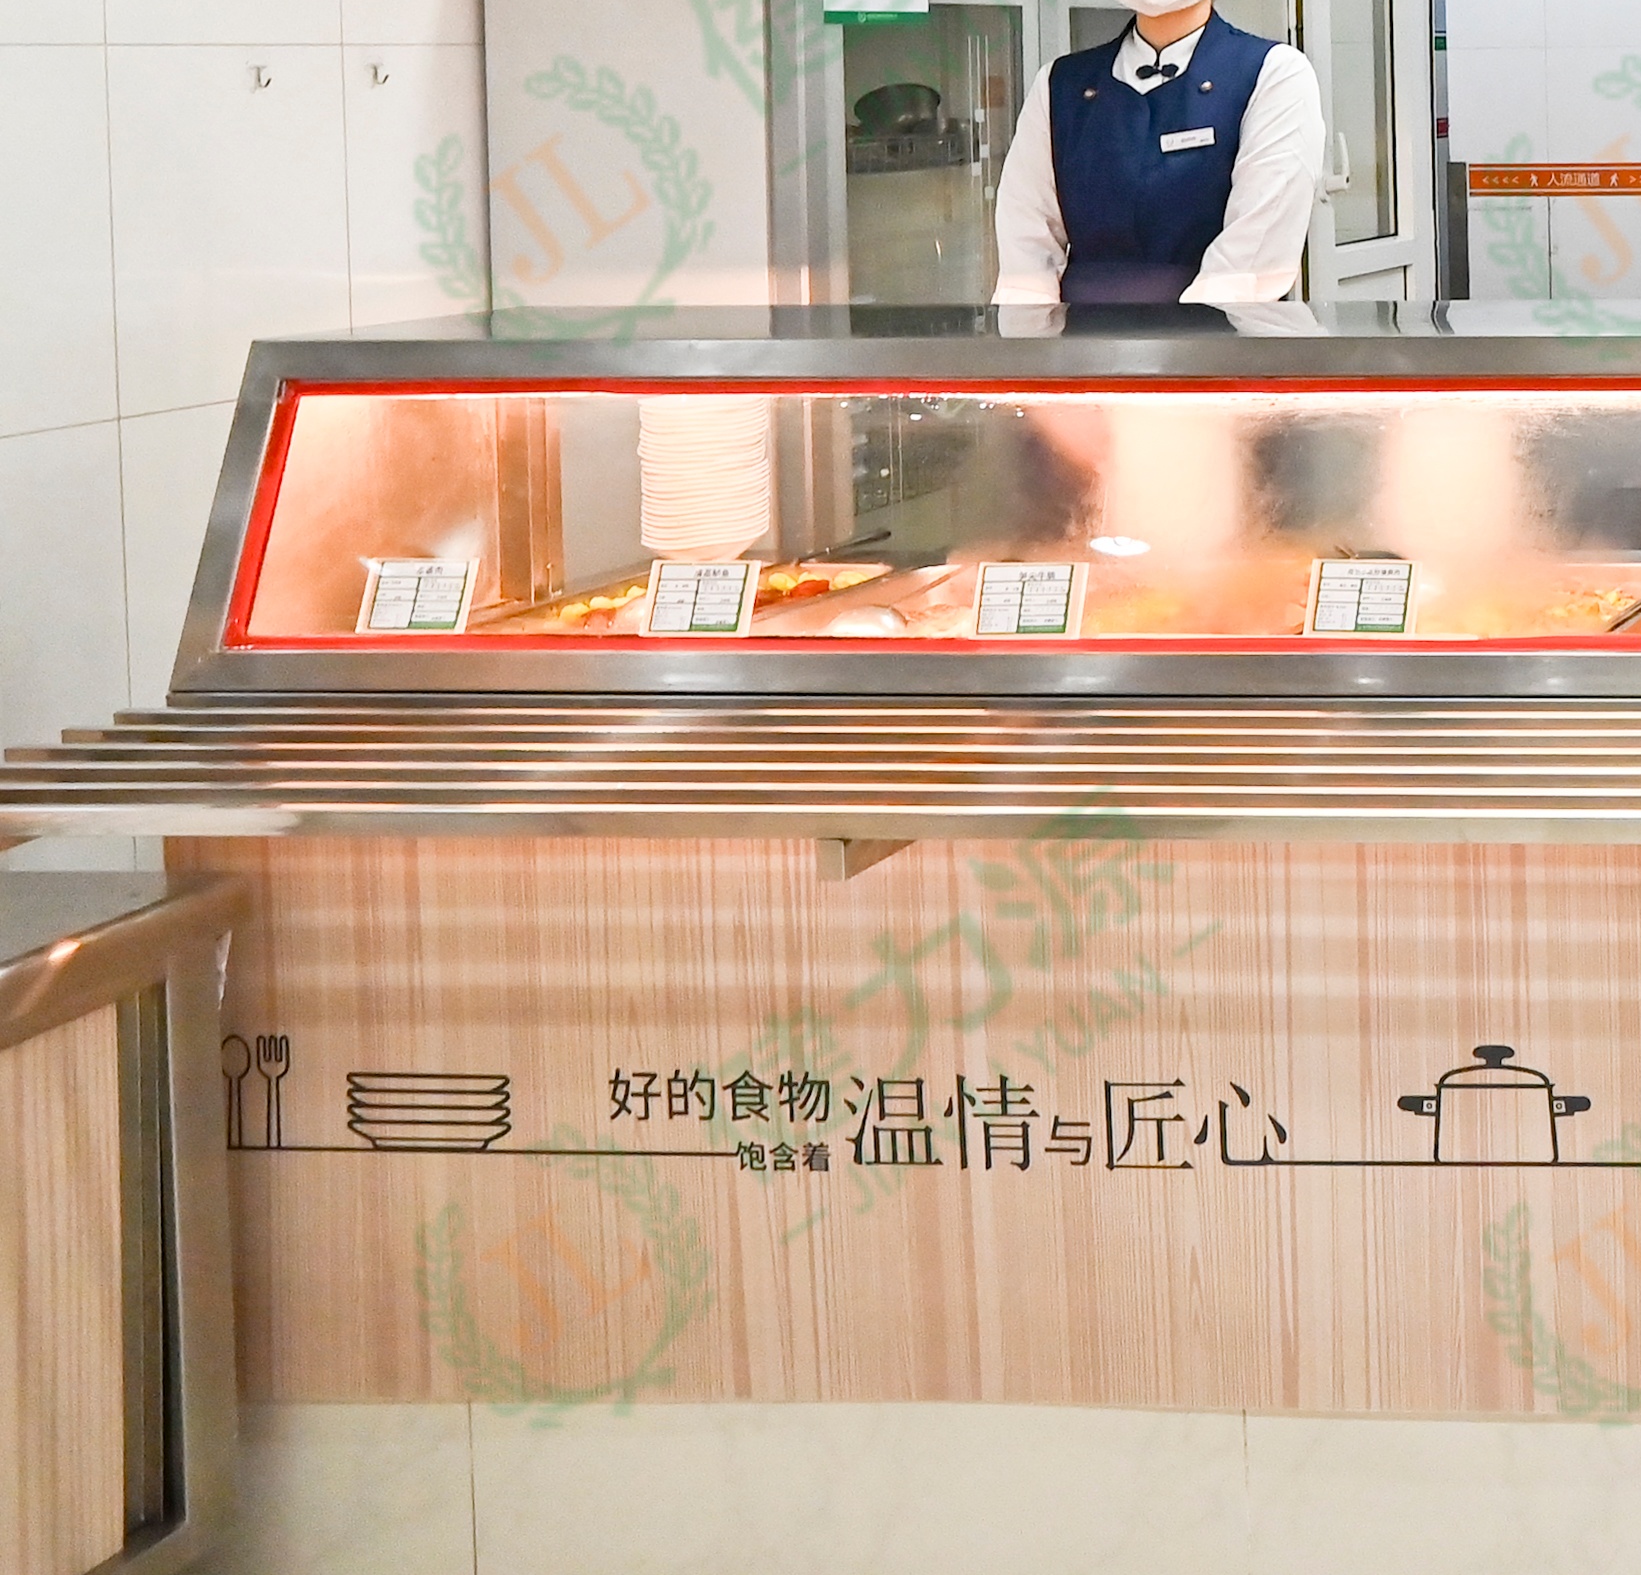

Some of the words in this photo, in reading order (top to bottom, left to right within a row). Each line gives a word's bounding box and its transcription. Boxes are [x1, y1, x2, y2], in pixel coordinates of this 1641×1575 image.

[1547, 172, 1601, 187] 人流通道
[607, 1069, 832, 1125] 好的食物
[844, 1072, 1290, 1173] 温情与匠心
[734, 1139, 832, 1174] 饱含着
